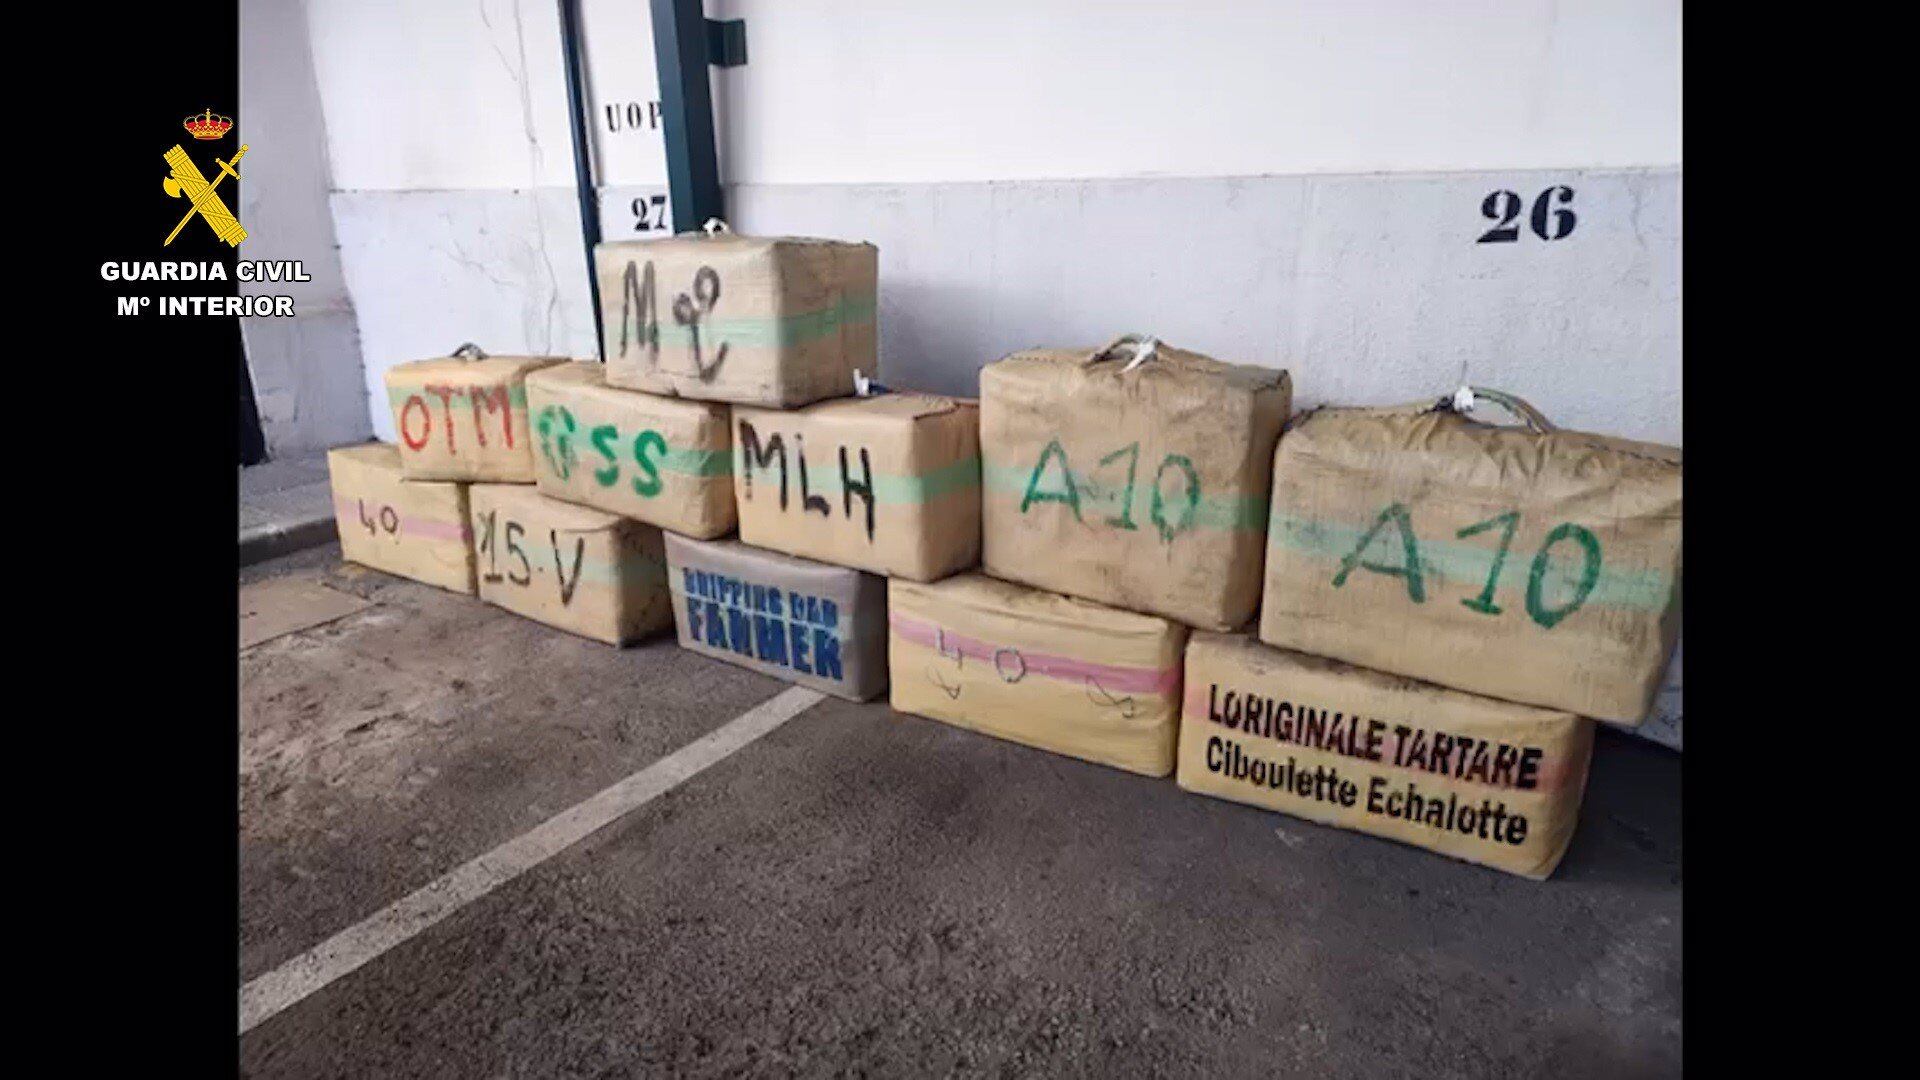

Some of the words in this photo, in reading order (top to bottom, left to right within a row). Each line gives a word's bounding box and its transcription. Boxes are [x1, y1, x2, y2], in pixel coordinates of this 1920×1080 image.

[632, 194, 667, 232] 27
[1475, 184, 1578, 244] 26
[400, 382, 515, 456] OTM
[738, 417, 876, 544] MLH
[1019, 436, 1202, 546] A10
[1330, 502, 1602, 629] A10
[1206, 735, 1358, 808] Ciboulette
[1366, 776, 1529, 846] Echalotte
[1207, 683, 1386, 763] LORIGINALE
[1393, 723, 1544, 790] TARTARE
